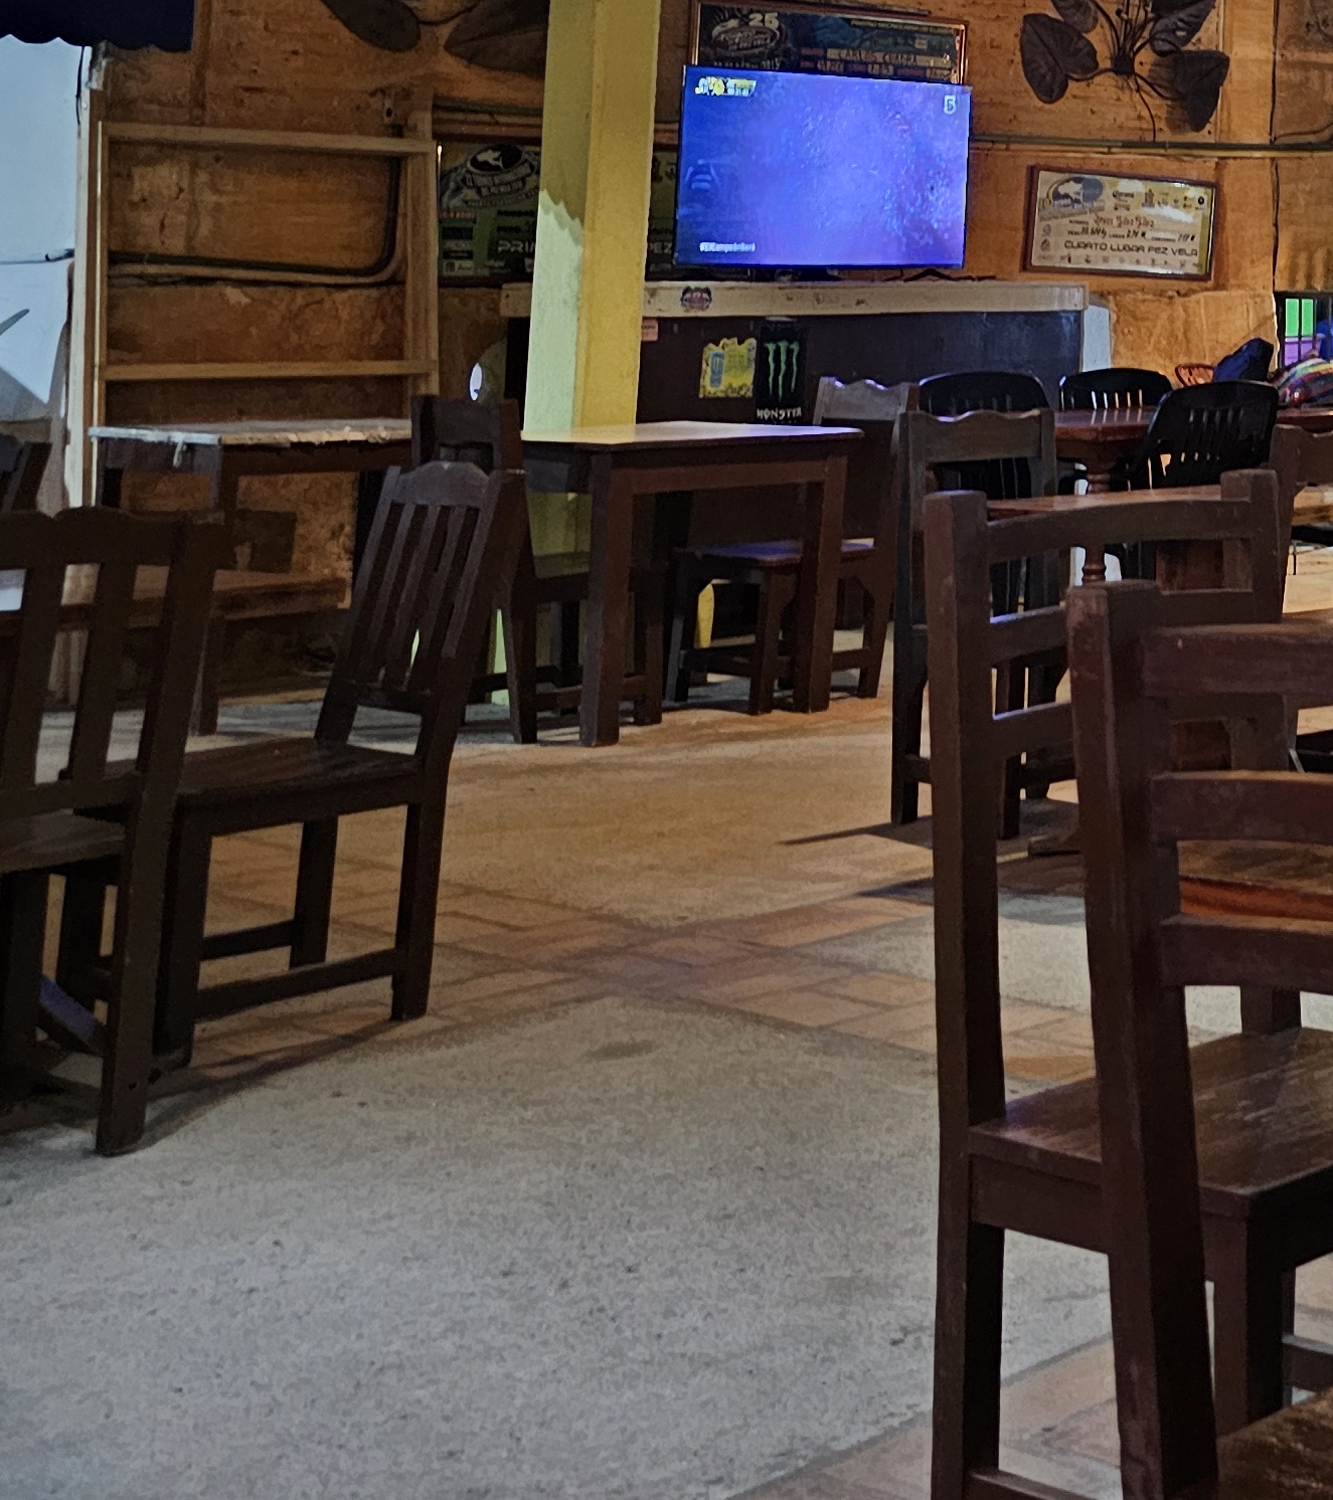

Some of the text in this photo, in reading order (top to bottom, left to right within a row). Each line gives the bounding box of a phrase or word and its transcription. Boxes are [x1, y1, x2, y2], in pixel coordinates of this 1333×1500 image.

[748, 12, 779, 29] 25
[1148, 245, 1168, 255] PEZ
[1171, 247, 1198, 257] VELA
